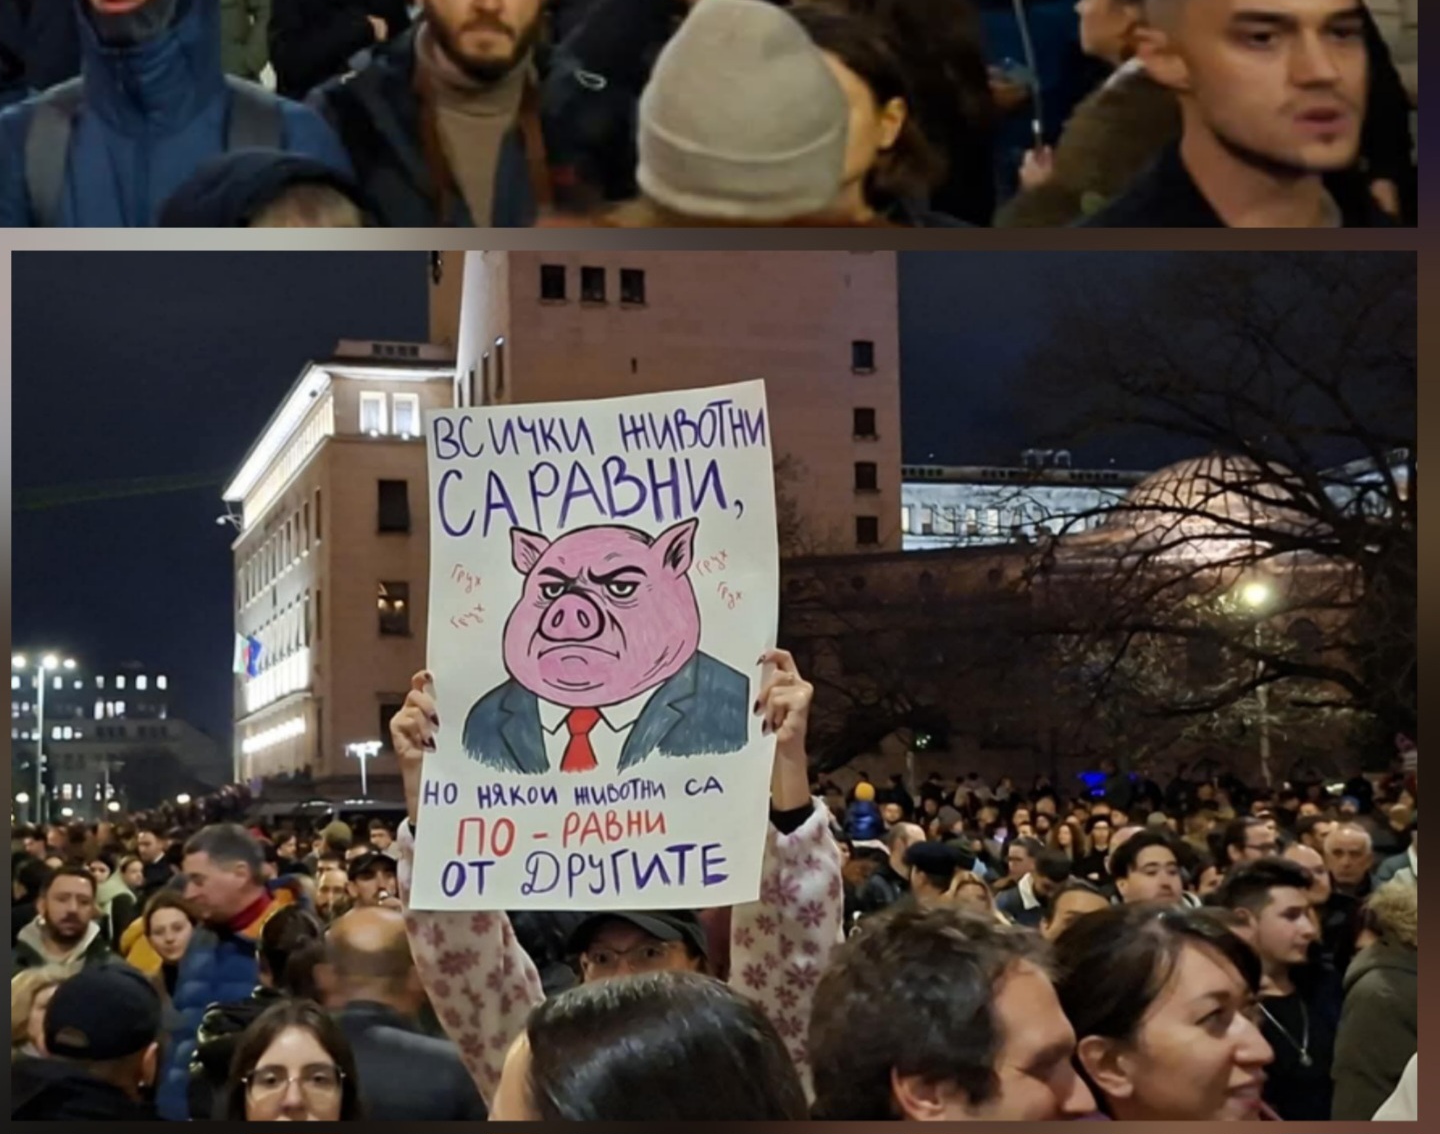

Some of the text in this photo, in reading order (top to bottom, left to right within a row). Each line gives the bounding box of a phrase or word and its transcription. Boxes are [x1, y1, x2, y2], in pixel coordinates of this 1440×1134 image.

[433, 399, 766, 460] ВСИЧКИ ЖИВОТНИ
[423, 776, 724, 809] НО НЯКОИ ЖИВОТНИ СА
[441, 843, 730, 899] ОТ ДРУГИТЕ
